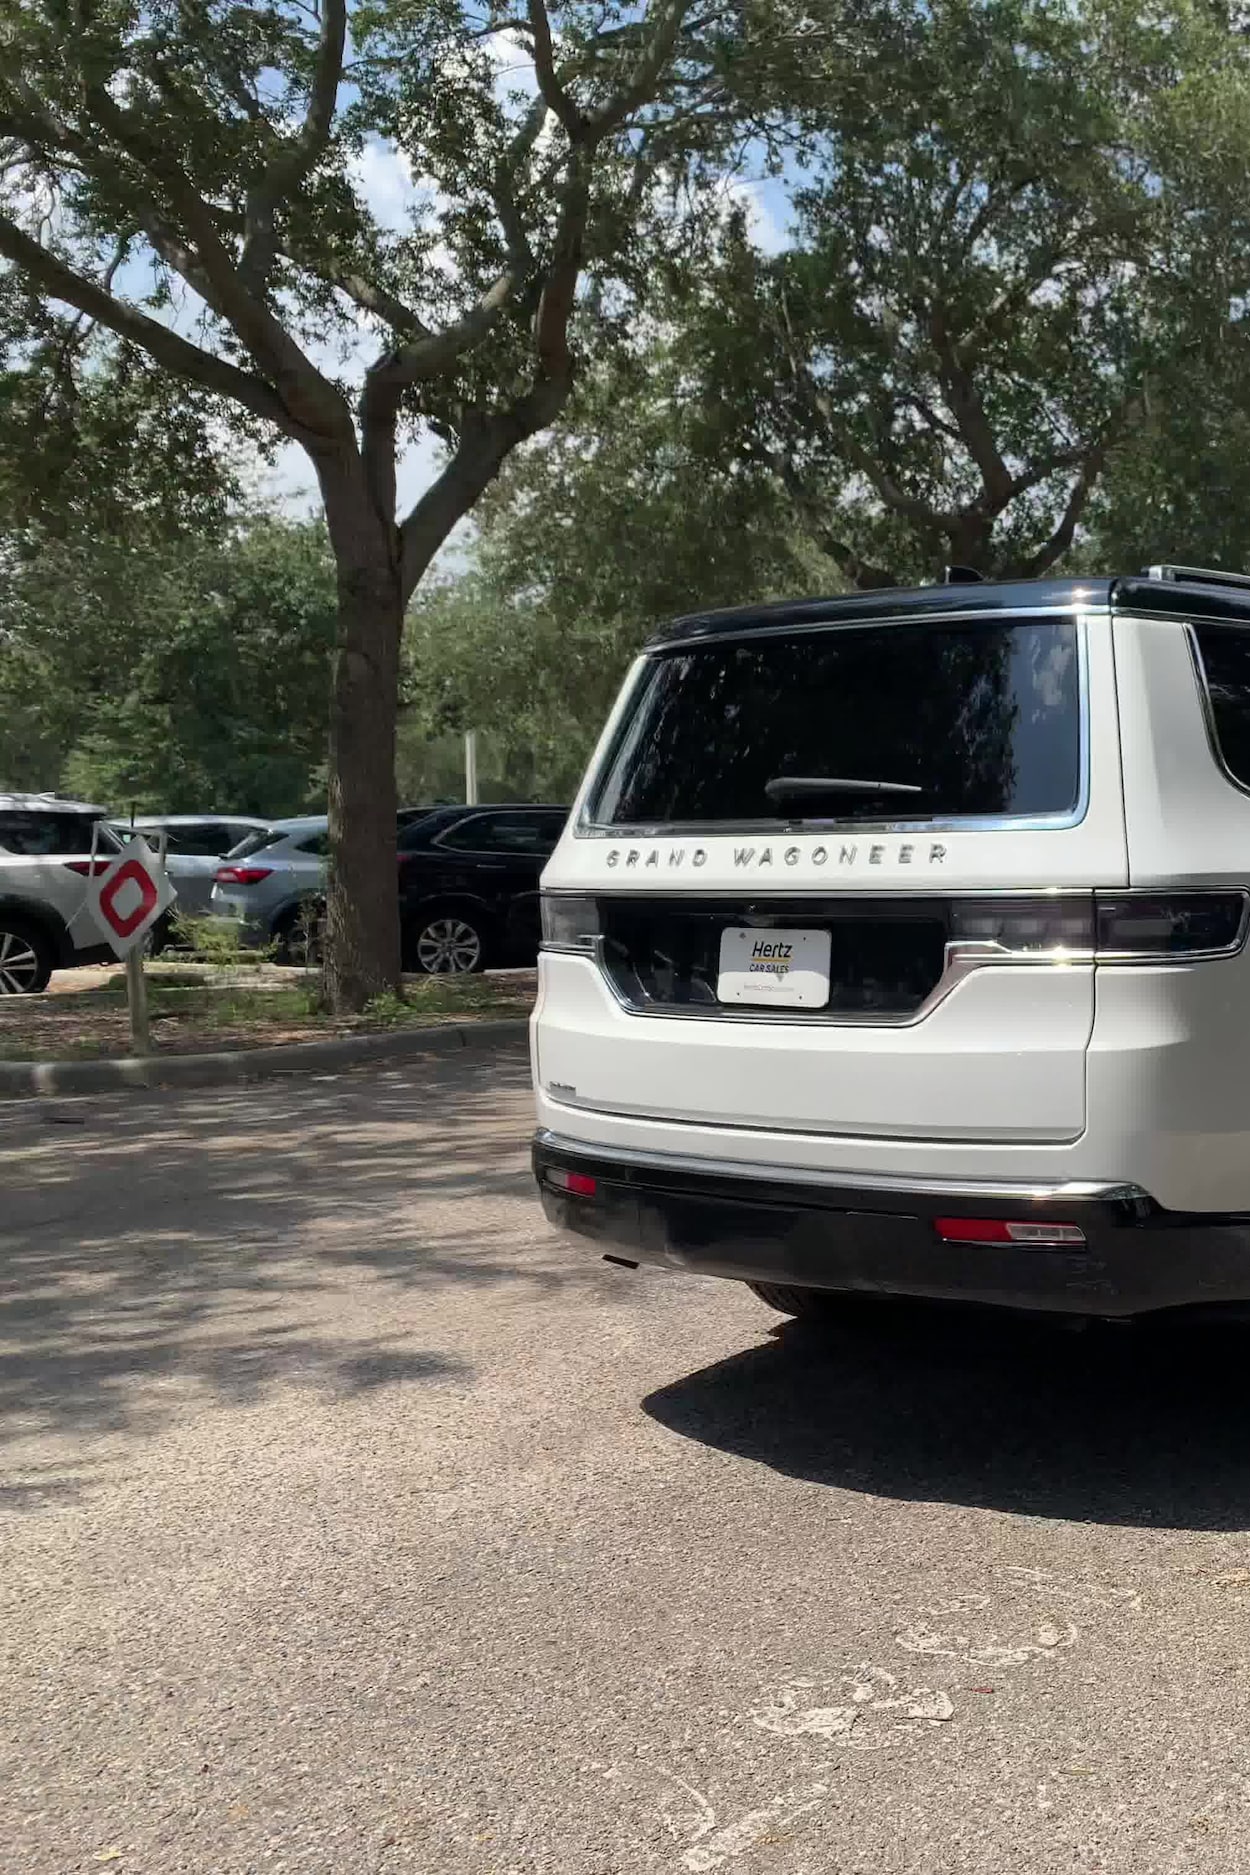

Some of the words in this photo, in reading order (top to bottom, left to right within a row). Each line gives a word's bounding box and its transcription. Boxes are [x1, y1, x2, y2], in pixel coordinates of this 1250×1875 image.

[605, 848, 709, 868] GRAND
[733, 843, 948, 868] WAGONEER
[752, 940, 793, 958] Hertz
[749, 963, 766, 973] CAR
[766, 963, 790, 974] SALES
